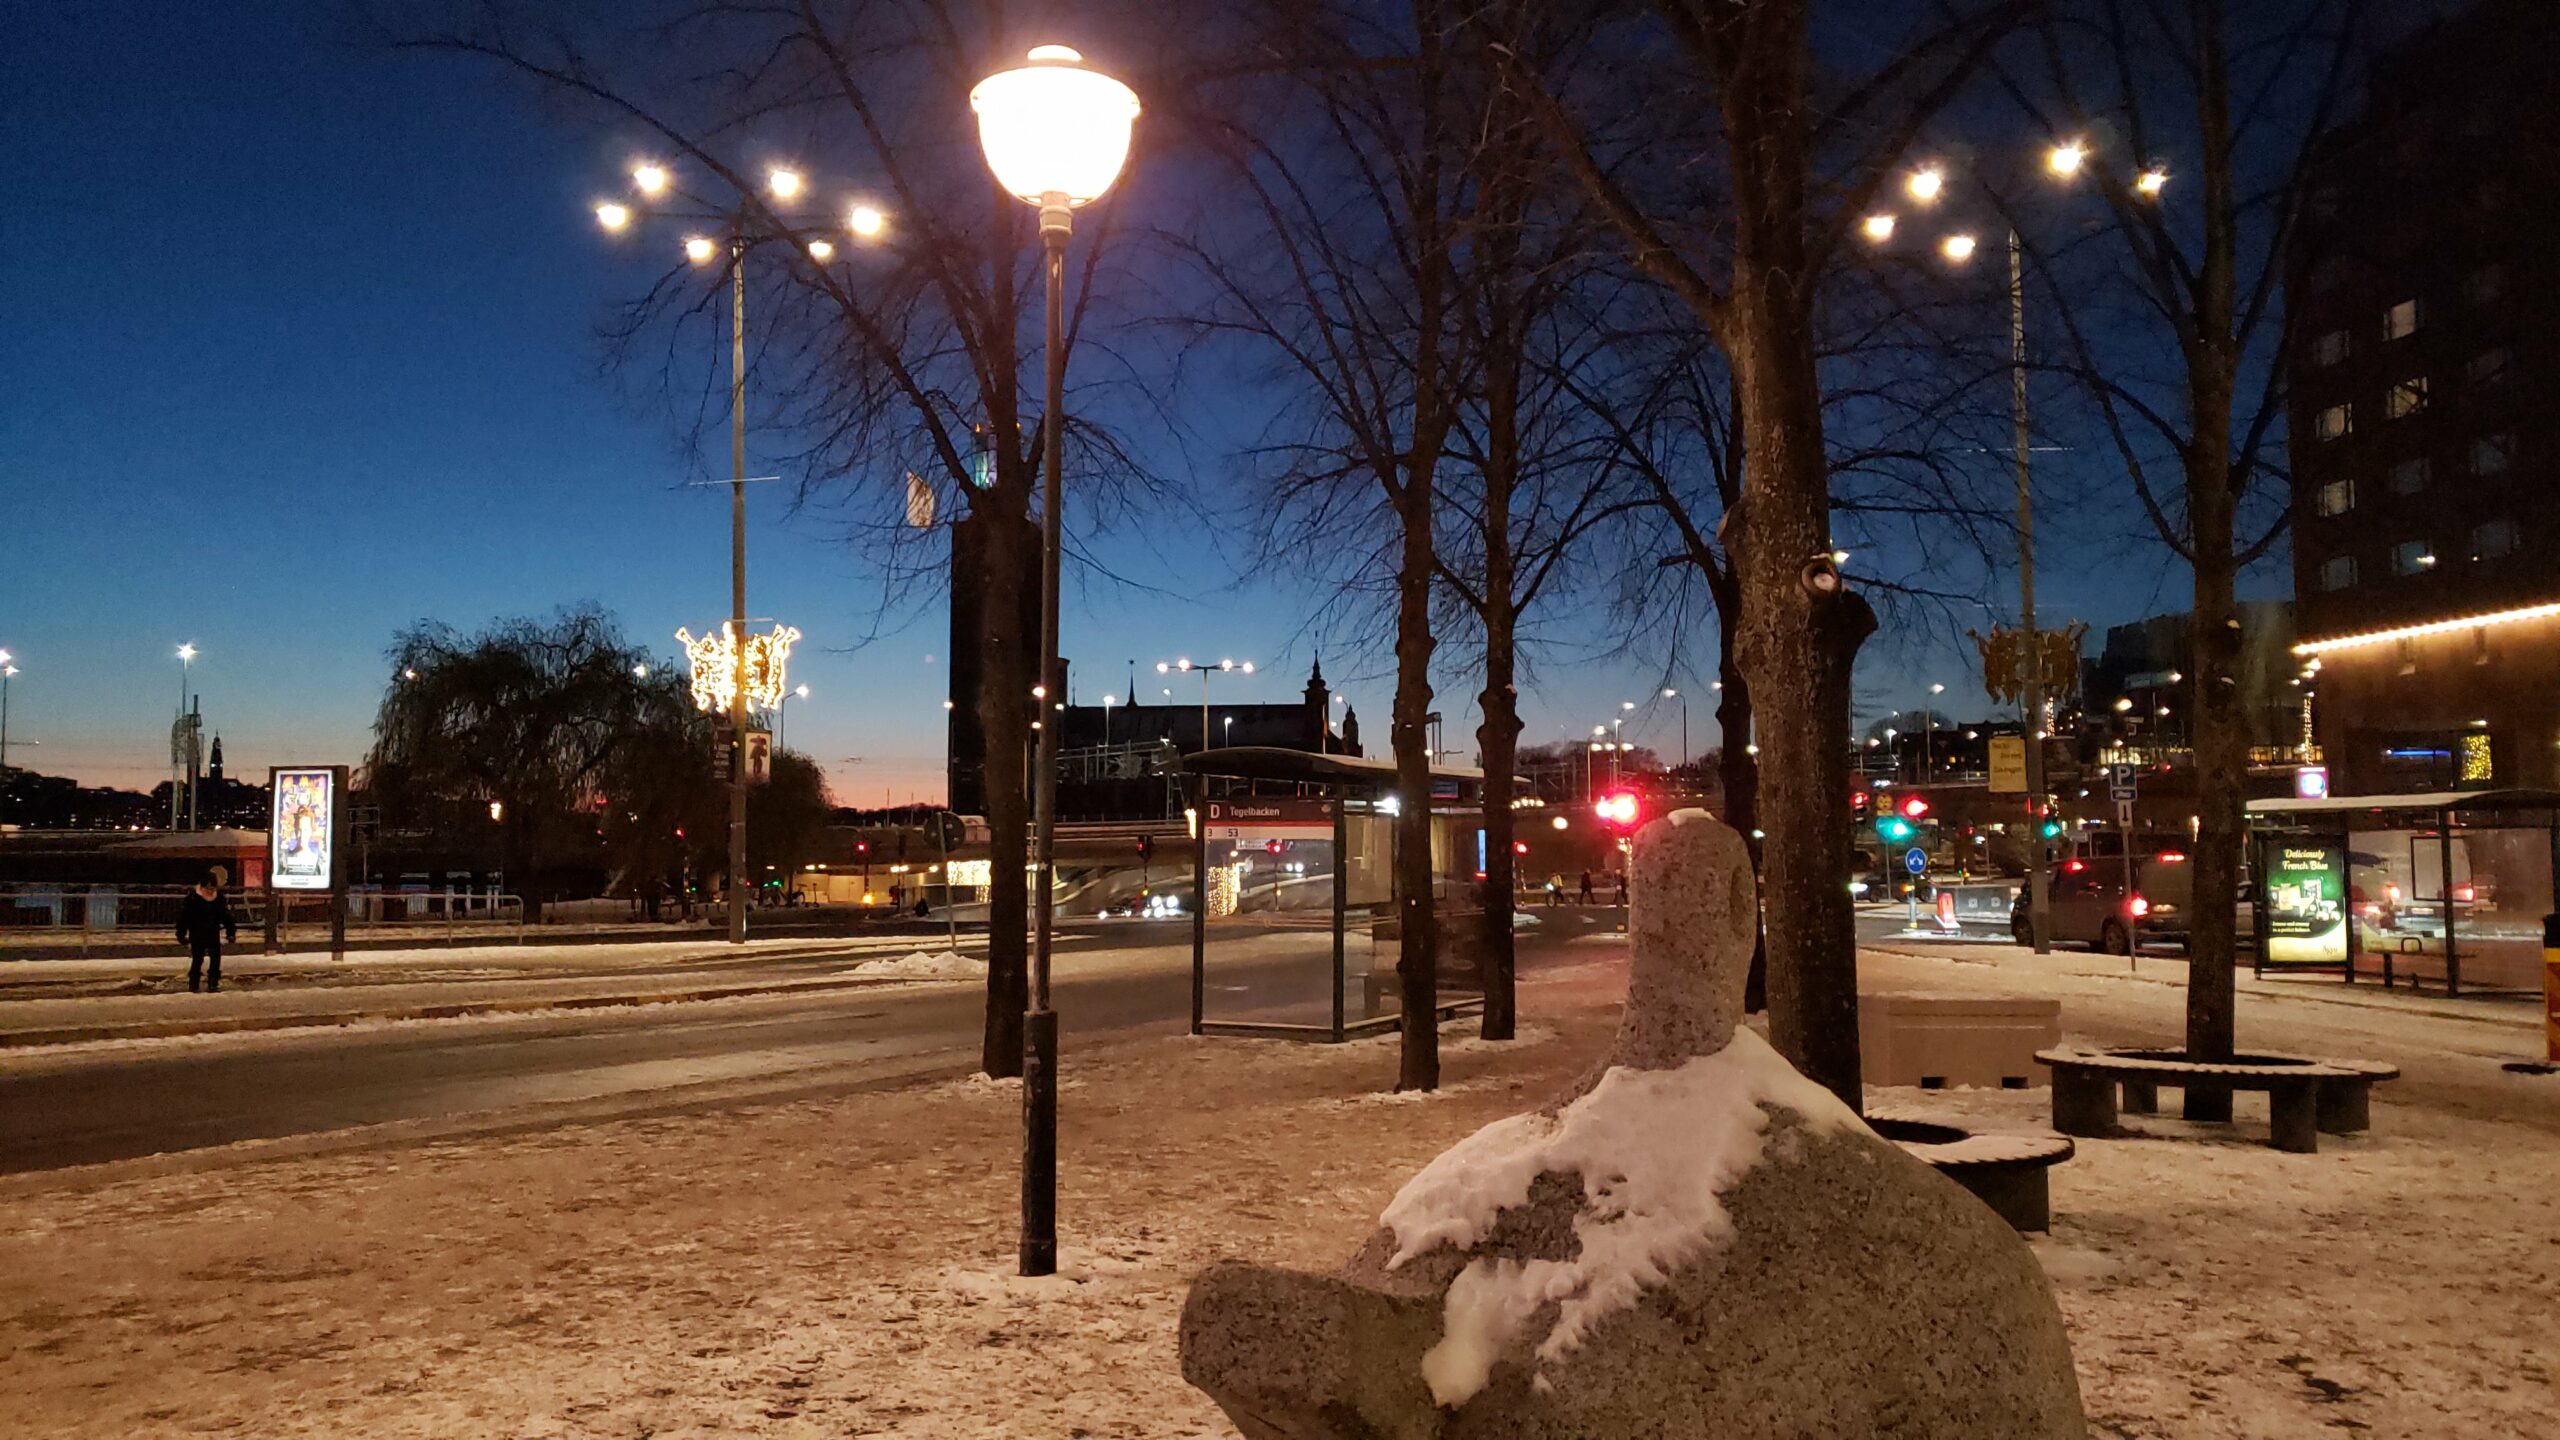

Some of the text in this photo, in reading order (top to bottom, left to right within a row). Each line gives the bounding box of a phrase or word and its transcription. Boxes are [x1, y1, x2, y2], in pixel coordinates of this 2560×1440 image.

[2117, 766, 2130, 785] P
[1210, 804, 1279, 818] D Tegelbacken
[1228, 828, 1239, 837] 53
[2284, 849, 2325, 860] Deliciously
[2282, 860, 2329, 870] French Blue
